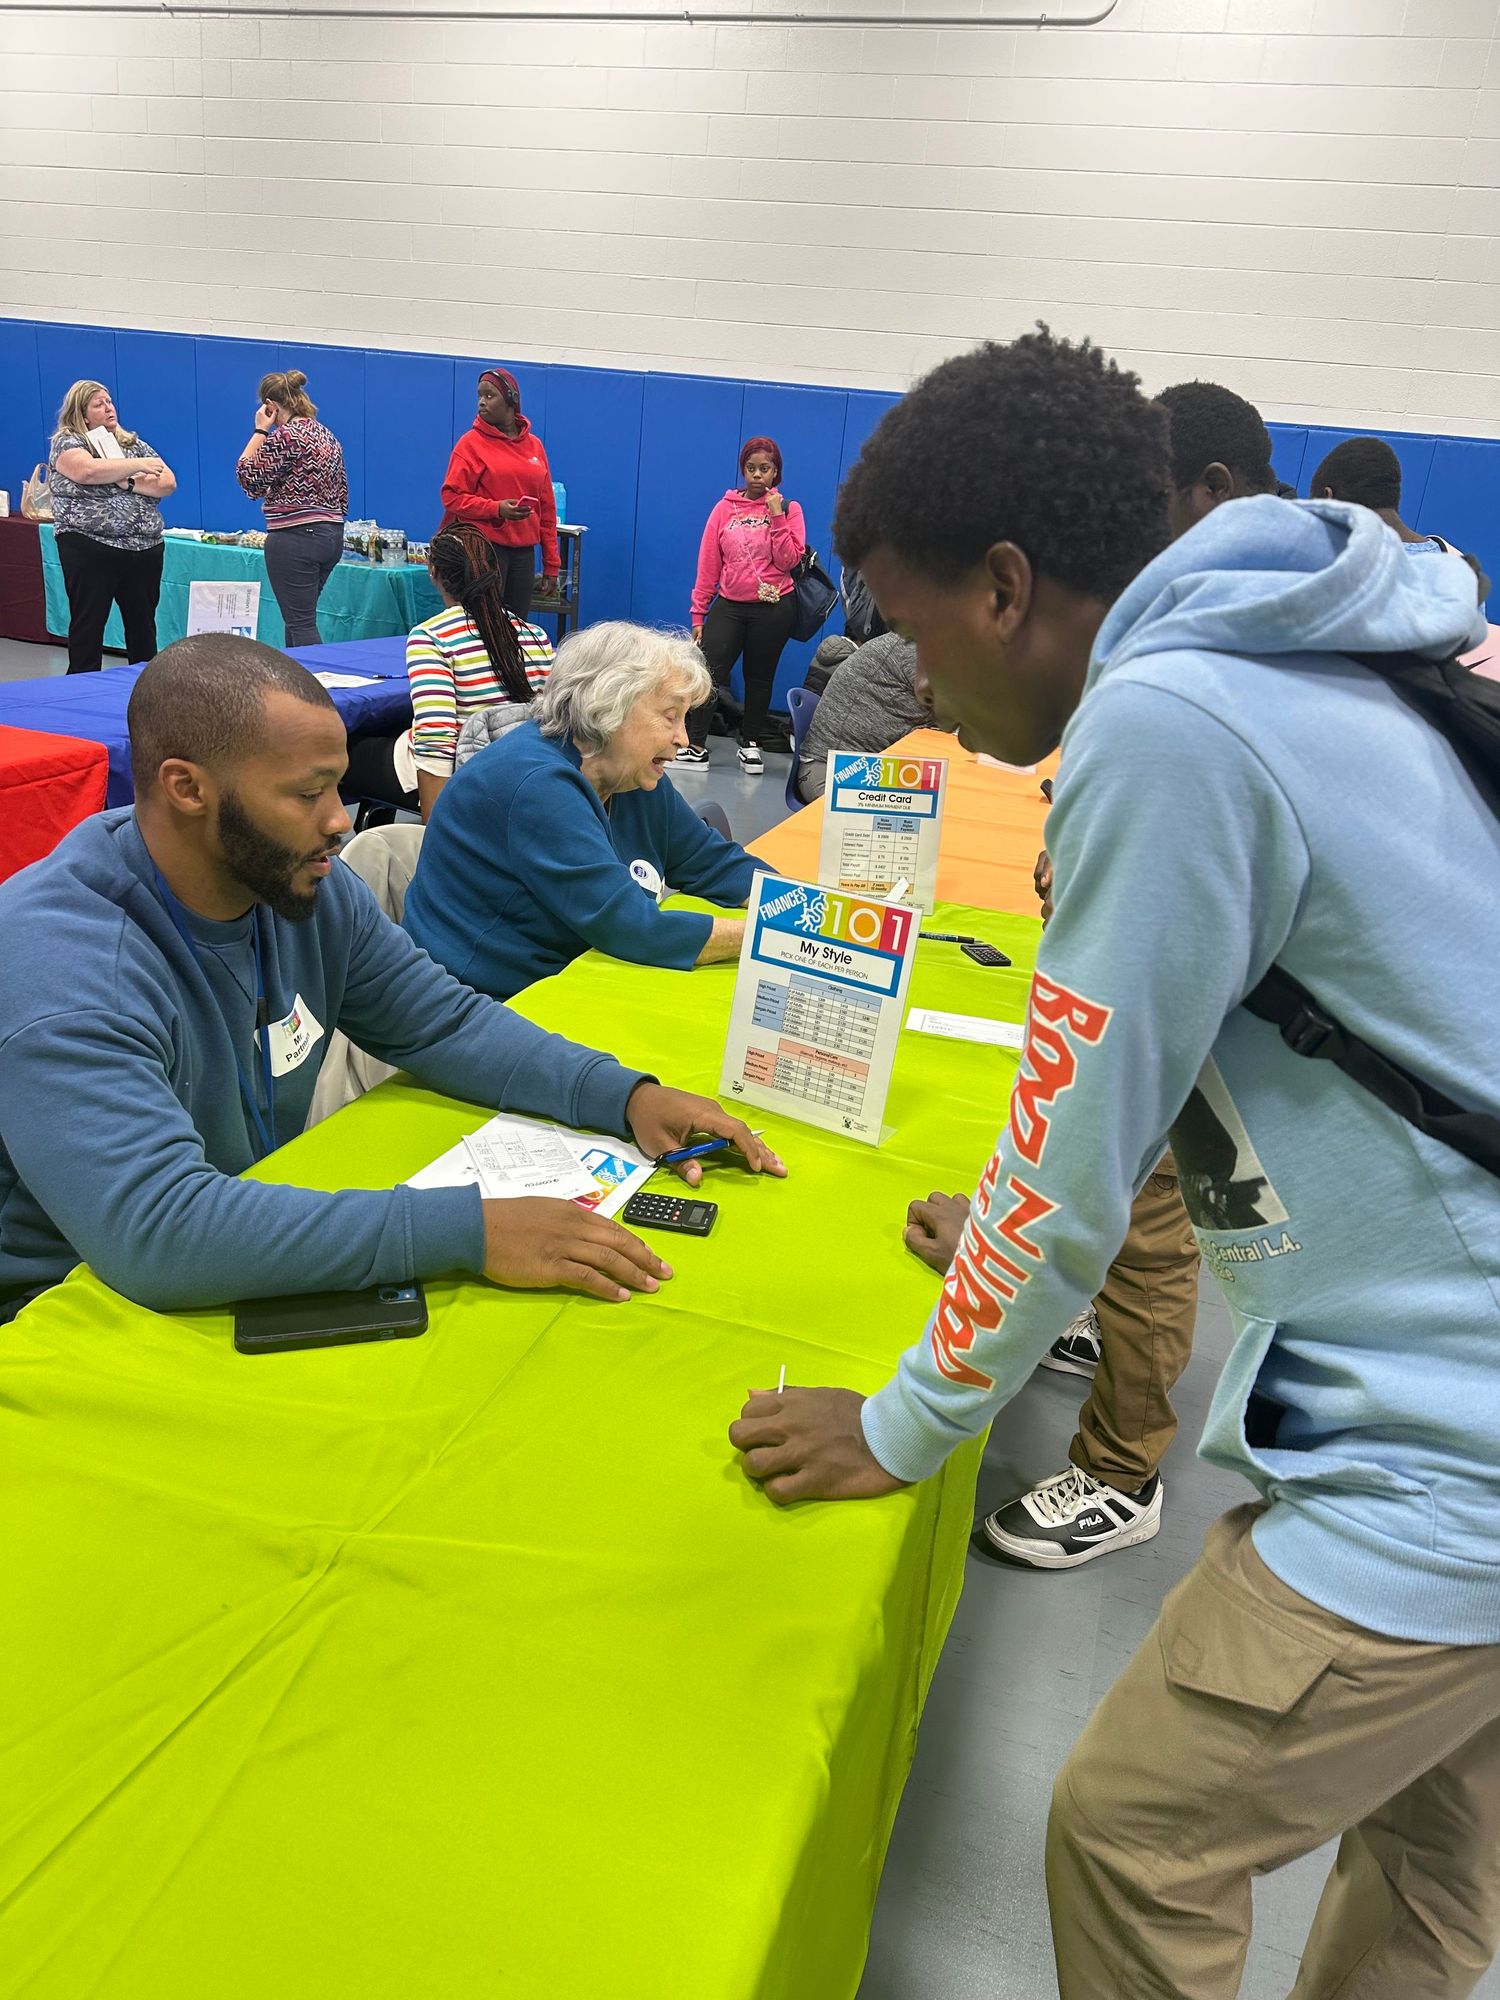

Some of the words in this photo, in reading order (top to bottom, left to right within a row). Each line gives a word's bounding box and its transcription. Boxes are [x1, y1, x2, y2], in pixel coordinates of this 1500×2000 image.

[834, 756, 869, 784] FINANCES
[858, 792, 887, 802] Credit
[888, 794, 912, 804] Card
[759, 886, 808, 921] FINANCES
[781, 951, 794, 960] PICK
[794, 954, 807, 963] ONE
[808, 958, 816, 966] OF
[817, 960, 833, 970] EACH
[834, 964, 845, 974] PER
[846, 968, 868, 980] PERSON
[800, 940, 820, 956] My
[822, 947, 852, 965] Style
[992, 1171, 1063, 1264] N
[1210, 1240, 1264, 1262] Central
[1260, 1232, 1302, 1258] L.A.
[1078, 1514, 1104, 1530] FILA
